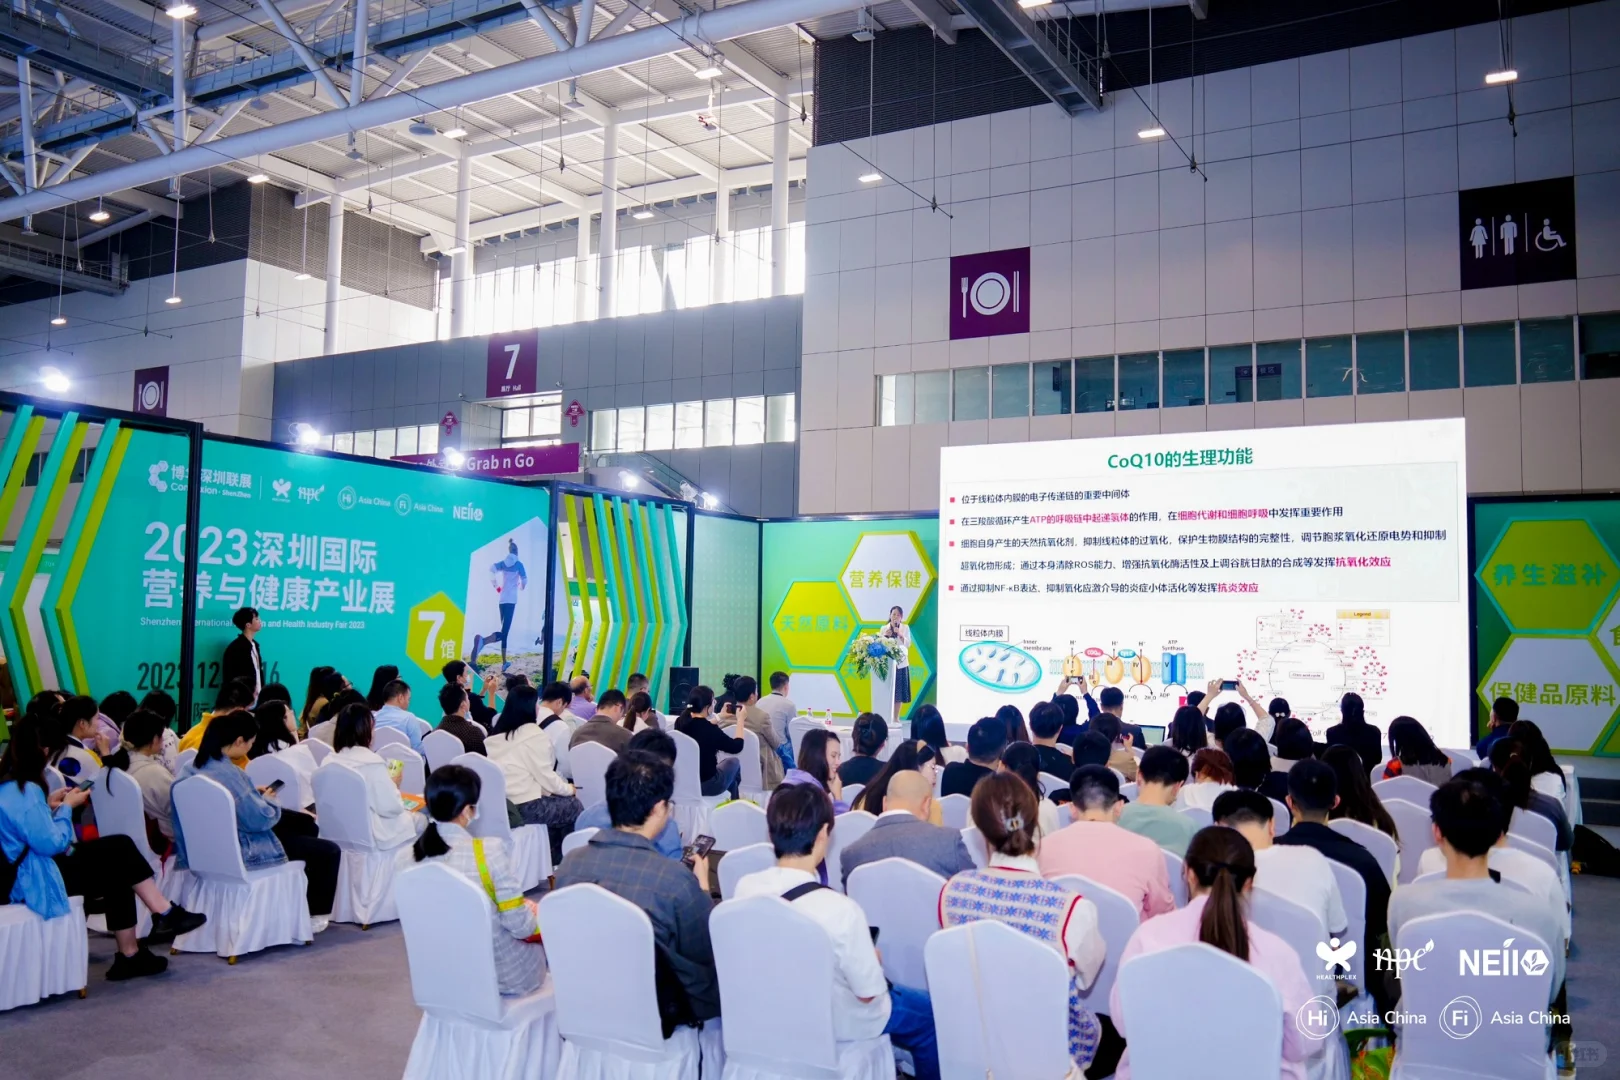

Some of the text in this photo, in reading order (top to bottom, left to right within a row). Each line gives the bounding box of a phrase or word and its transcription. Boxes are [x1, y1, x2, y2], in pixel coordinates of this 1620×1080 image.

[504, 344, 520, 379] 7
[466, 454, 499, 471] Grab
[502, 459, 511, 468] n
[514, 453, 534, 468] Go
[1108, 447, 1253, 469] CoQ10的生理功能
[171, 464, 252, 489] 博深圳联展
[171, 482, 217, 495] Conxion
[961, 489, 1130, 504] 位于线粒体内膜的电子传递链的重要中间体
[358, 496, 372, 505] Asia
[849, 570, 921, 589] 营养保健
[1493, 563, 1607, 586] 养生滋补
[140, 617, 182, 626] Shenzhen
[195, 618, 233, 627] ernational
[268, 619, 281, 628] and
[282, 620, 305, 628] Health
[306, 620, 334, 630] Industry
[335, 620, 347, 629] Fair
[348, 621, 365, 629] 2023
[780, 615, 848, 632] 天然原料
[965, 629, 1003, 638] 线粒体内膜
[1489, 682, 1616, 707] 保健品原料
